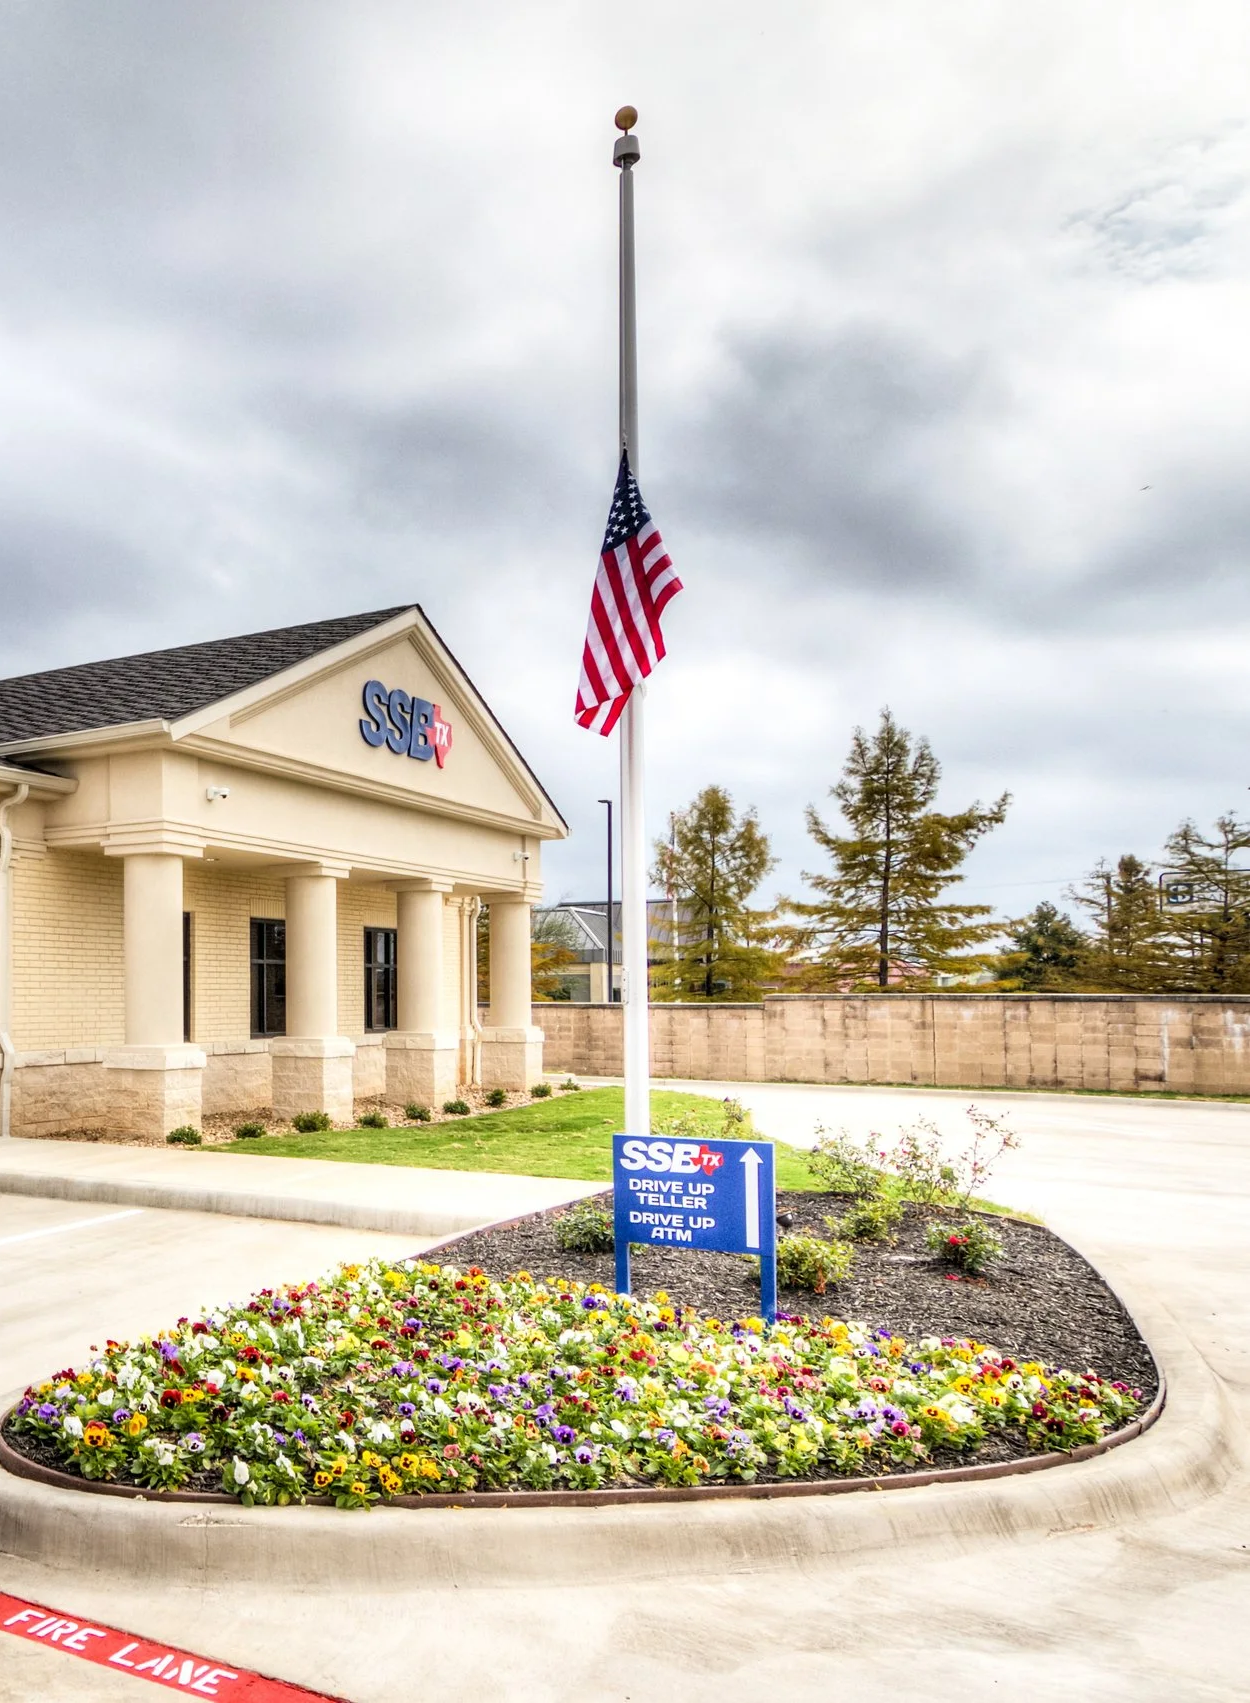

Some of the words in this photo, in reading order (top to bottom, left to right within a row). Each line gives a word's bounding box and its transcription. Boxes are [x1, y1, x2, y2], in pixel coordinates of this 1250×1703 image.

[359, 683, 435, 761] SSB
[434, 722, 449, 747] TX
[620, 1140, 701, 1174] SSB
[701, 1154, 721, 1167] TX
[629, 1178, 684, 1194] DRIVE
[688, 1183, 715, 1196] UP
[636, 1192, 708, 1210] TELLER
[629, 1211, 684, 1228] DRIVE
[689, 1217, 716, 1230] UP
[650, 1228, 693, 1242] ATM
[3, 1608, 107, 1650] FIRE
[108, 1643, 239, 1694] LANE
